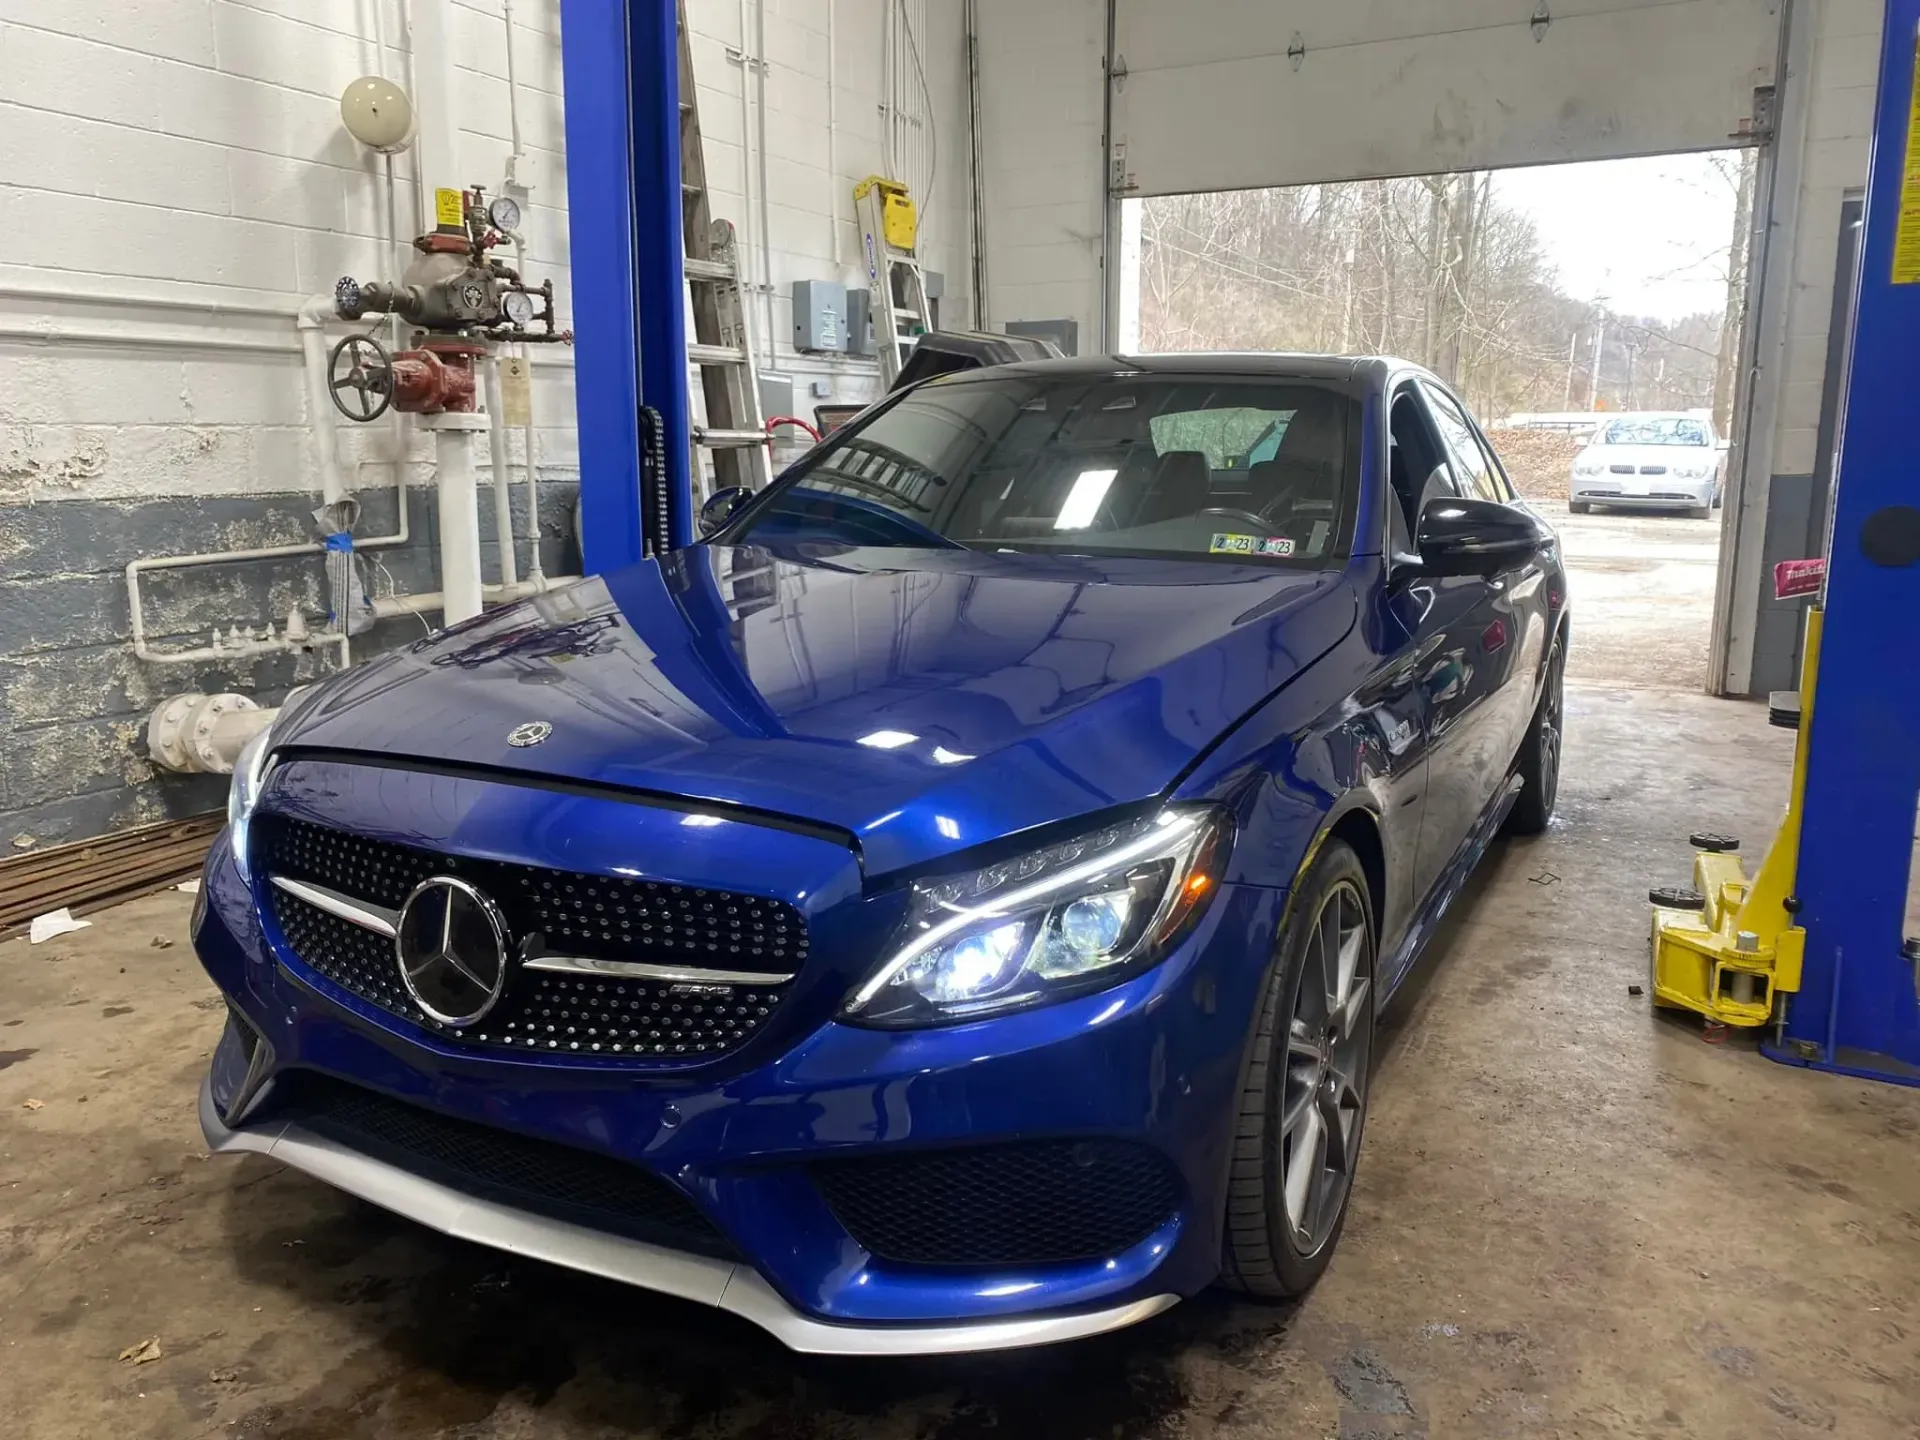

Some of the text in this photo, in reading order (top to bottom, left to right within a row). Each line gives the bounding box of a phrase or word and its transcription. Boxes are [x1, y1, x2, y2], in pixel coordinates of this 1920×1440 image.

[1236, 538, 1250, 551] 23
[1258, 540, 1291, 554] 2 23
